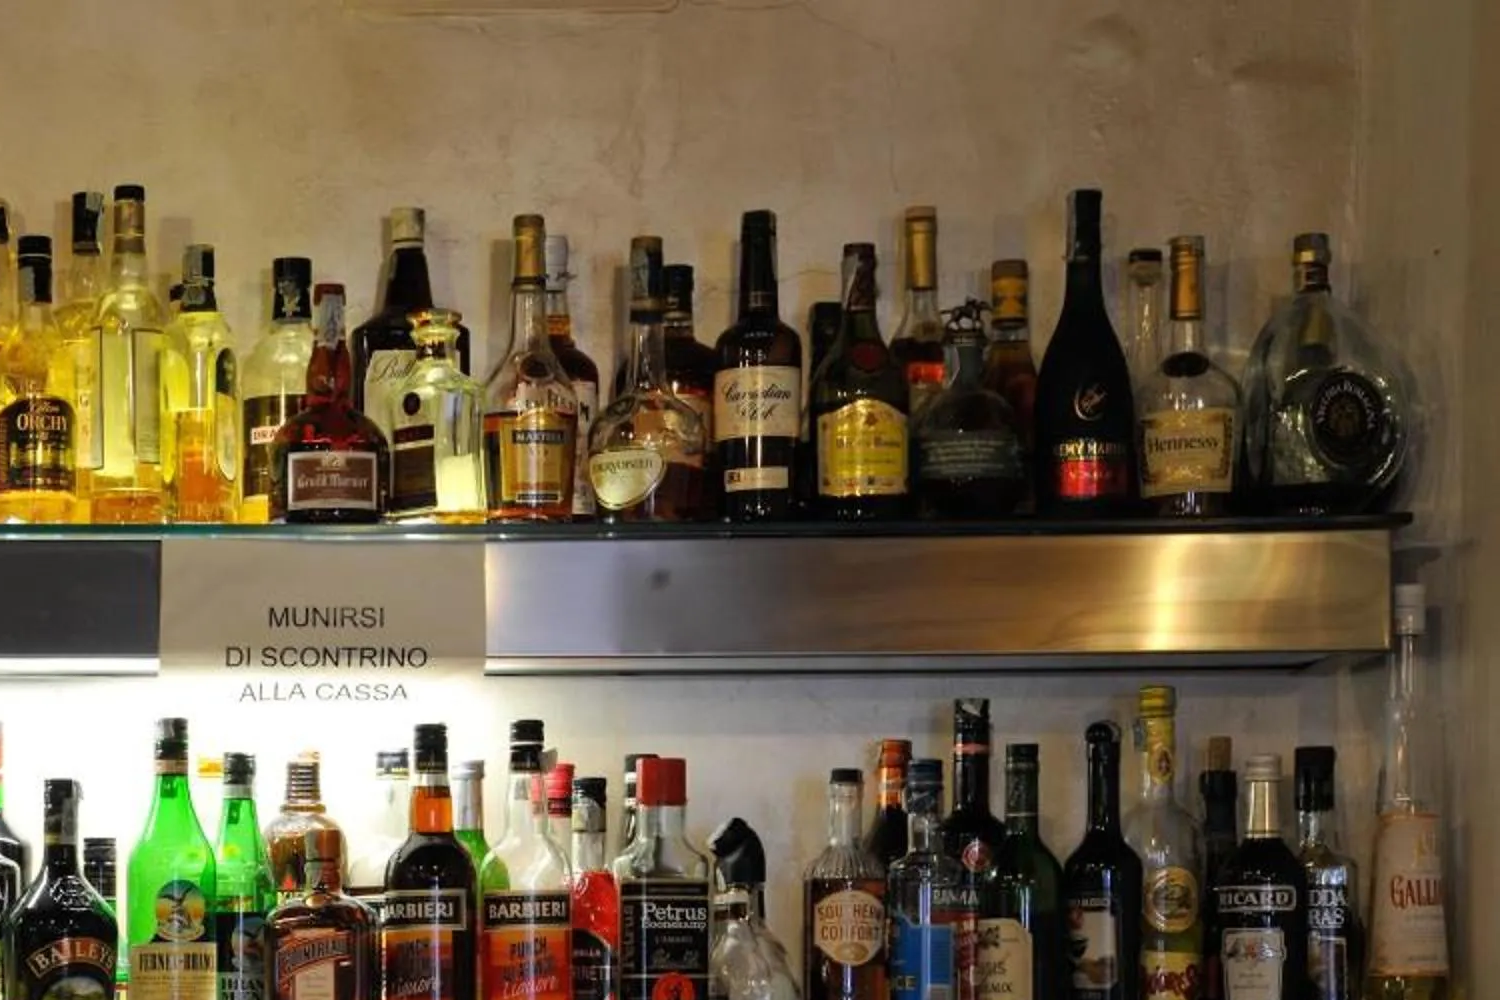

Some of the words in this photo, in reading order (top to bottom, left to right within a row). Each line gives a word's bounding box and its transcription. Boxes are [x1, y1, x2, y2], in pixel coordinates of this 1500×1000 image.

[1150, 434, 1220, 454] Hennessy
[268, 607, 385, 629] MUNIRSI
[225, 647, 250, 668] DI
[261, 646, 428, 669] SCONTRINO
[239, 682, 306, 702] ALLA
[315, 682, 409, 702] CASSA
[1308, 888, 1348, 907] DDA
[1390, 876, 1443, 909] GALLI
[488, 901, 567, 920] BARBIERI
[642, 902, 708, 922] Petrus
[1308, 908, 1345, 926] RAS
[35, 938, 114, 971] BAILEYS
